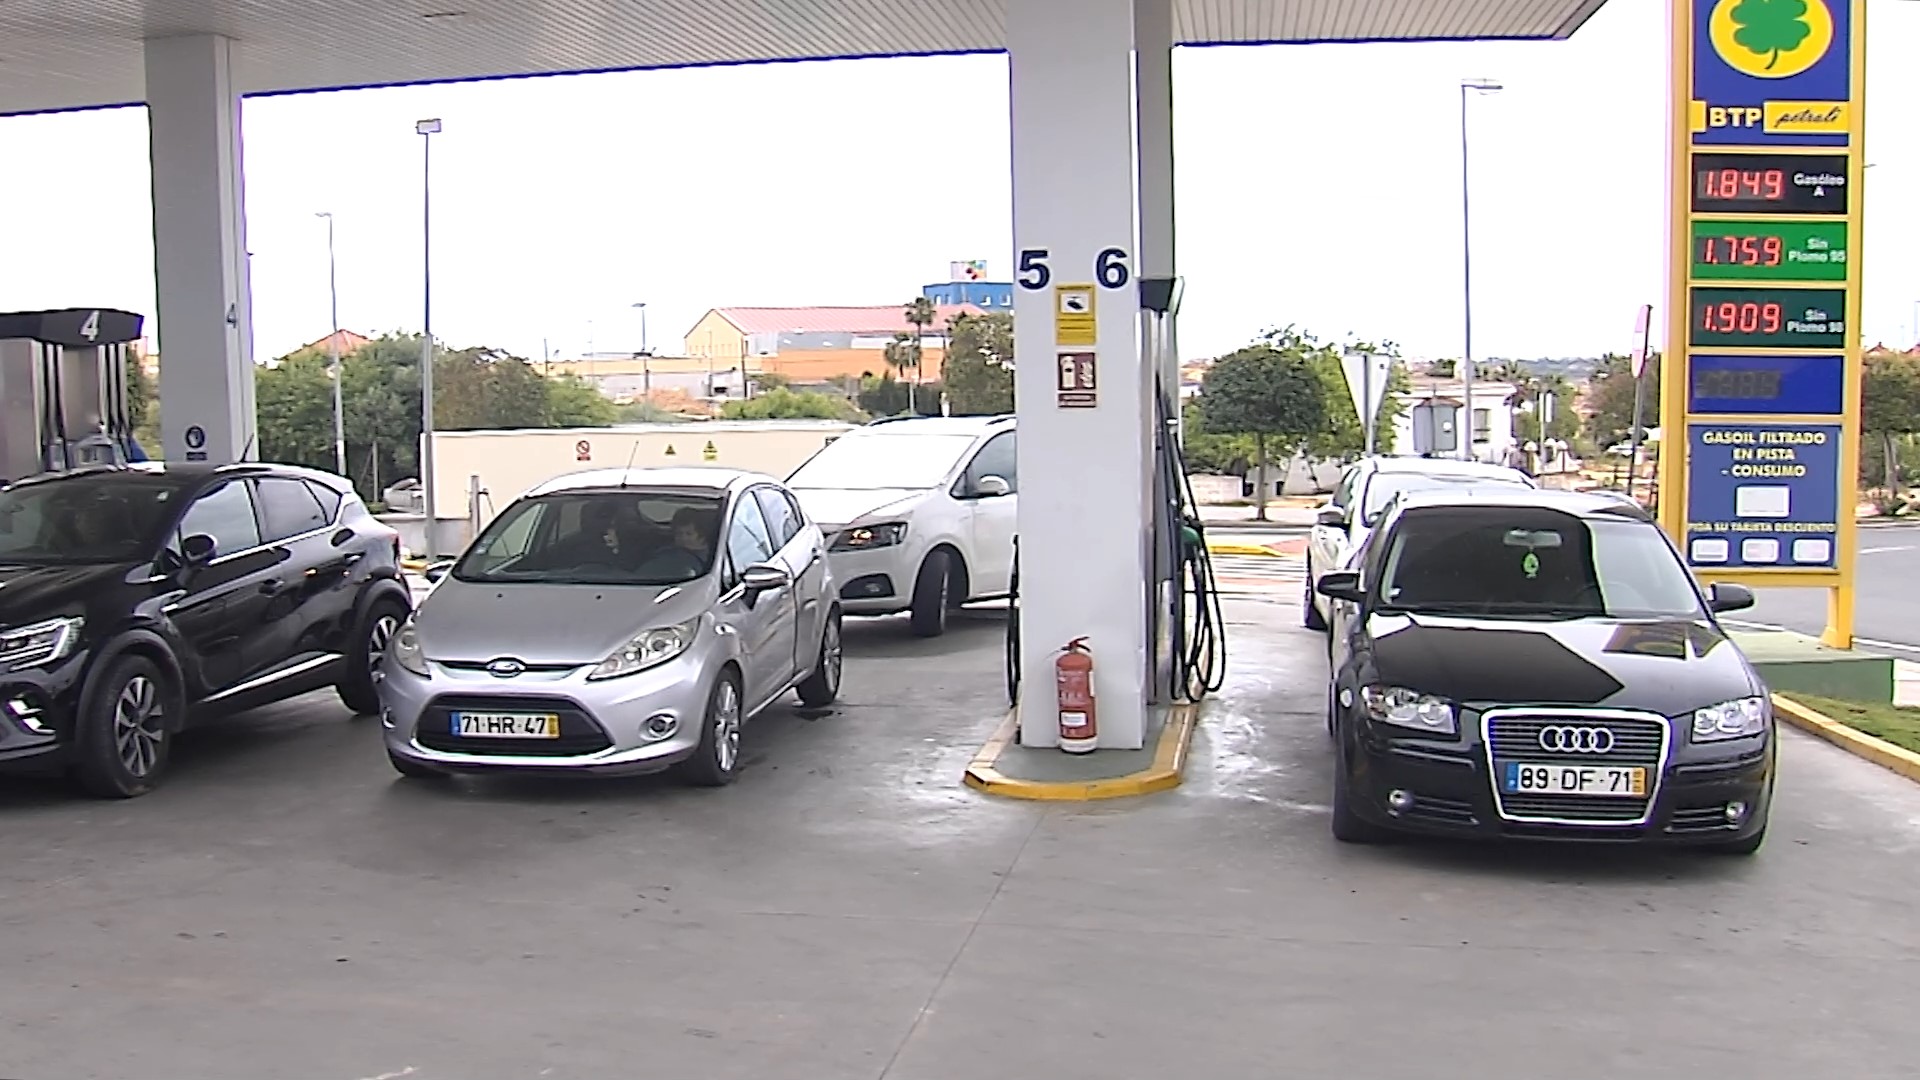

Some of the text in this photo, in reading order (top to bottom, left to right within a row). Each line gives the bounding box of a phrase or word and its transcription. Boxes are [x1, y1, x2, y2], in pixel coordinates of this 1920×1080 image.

[1708, 107, 1762, 128] BTP
[1706, 169, 1783, 199] 1.849
[1793, 172, 1845, 186] Gasóleo
[1813, 186, 1825, 197] A
[1704, 235, 1782, 266] 1.759
[1807, 238, 1829, 250] Sin
[1788, 250, 1828, 262] Plomo
[1018, 250, 1050, 290] 5
[1096, 248, 1128, 288] 6
[227, 303, 237, 328] 4
[1703, 302, 1781, 333] 1.909
[1804, 309, 1827, 321] Sin
[79, 309, 100, 342] 4
[1786, 320, 1827, 333] Plomo
[1702, 431, 1827, 445] GASOIL FILTRADO
[1732, 448, 1795, 461] EN PISTA
[1731, 464, 1807, 478] CONSUMO
[1774, 523, 1837, 533] DESCUENTO
